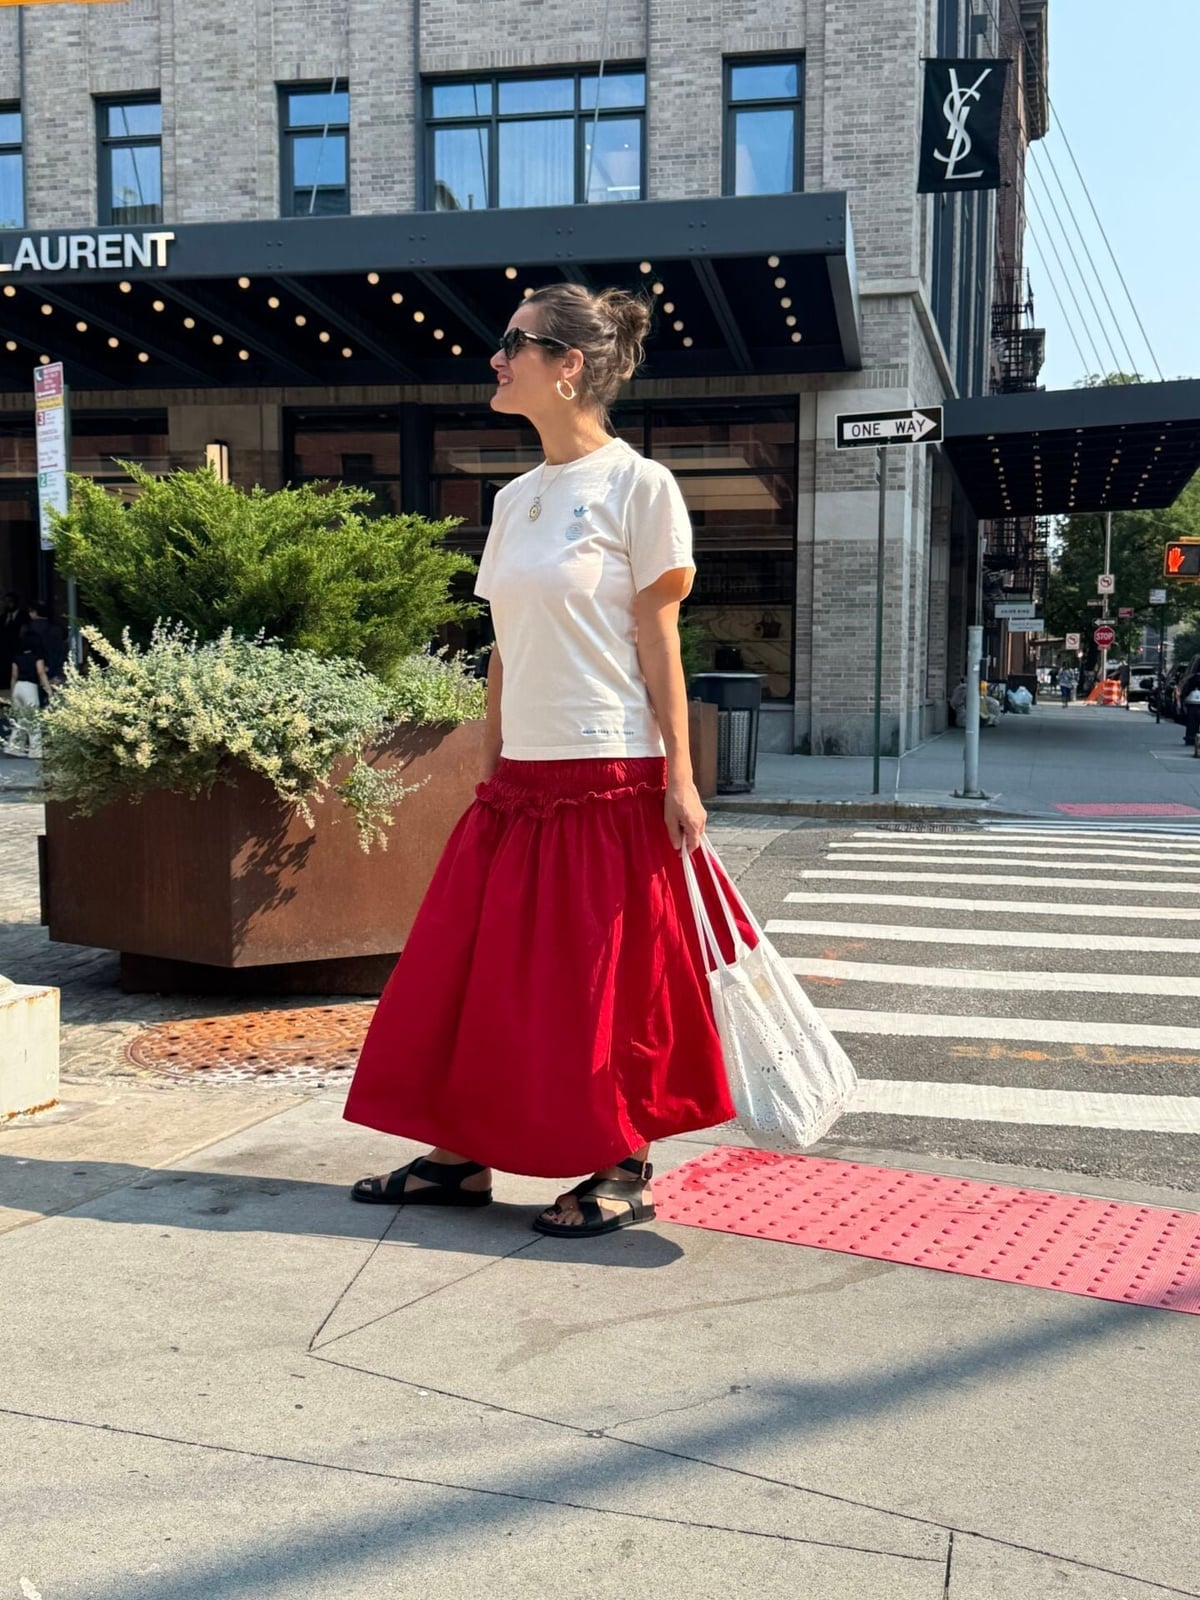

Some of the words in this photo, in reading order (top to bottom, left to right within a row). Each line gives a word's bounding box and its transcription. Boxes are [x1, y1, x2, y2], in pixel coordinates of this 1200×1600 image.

[933, 68, 992, 180] YSL
[38, 412, 44, 425] 3
[851, 422, 881, 437] ONE
[895, 419, 926, 434] WAY
[40, 473, 47, 487] 2
[1095, 632, 1113, 641] STOP
